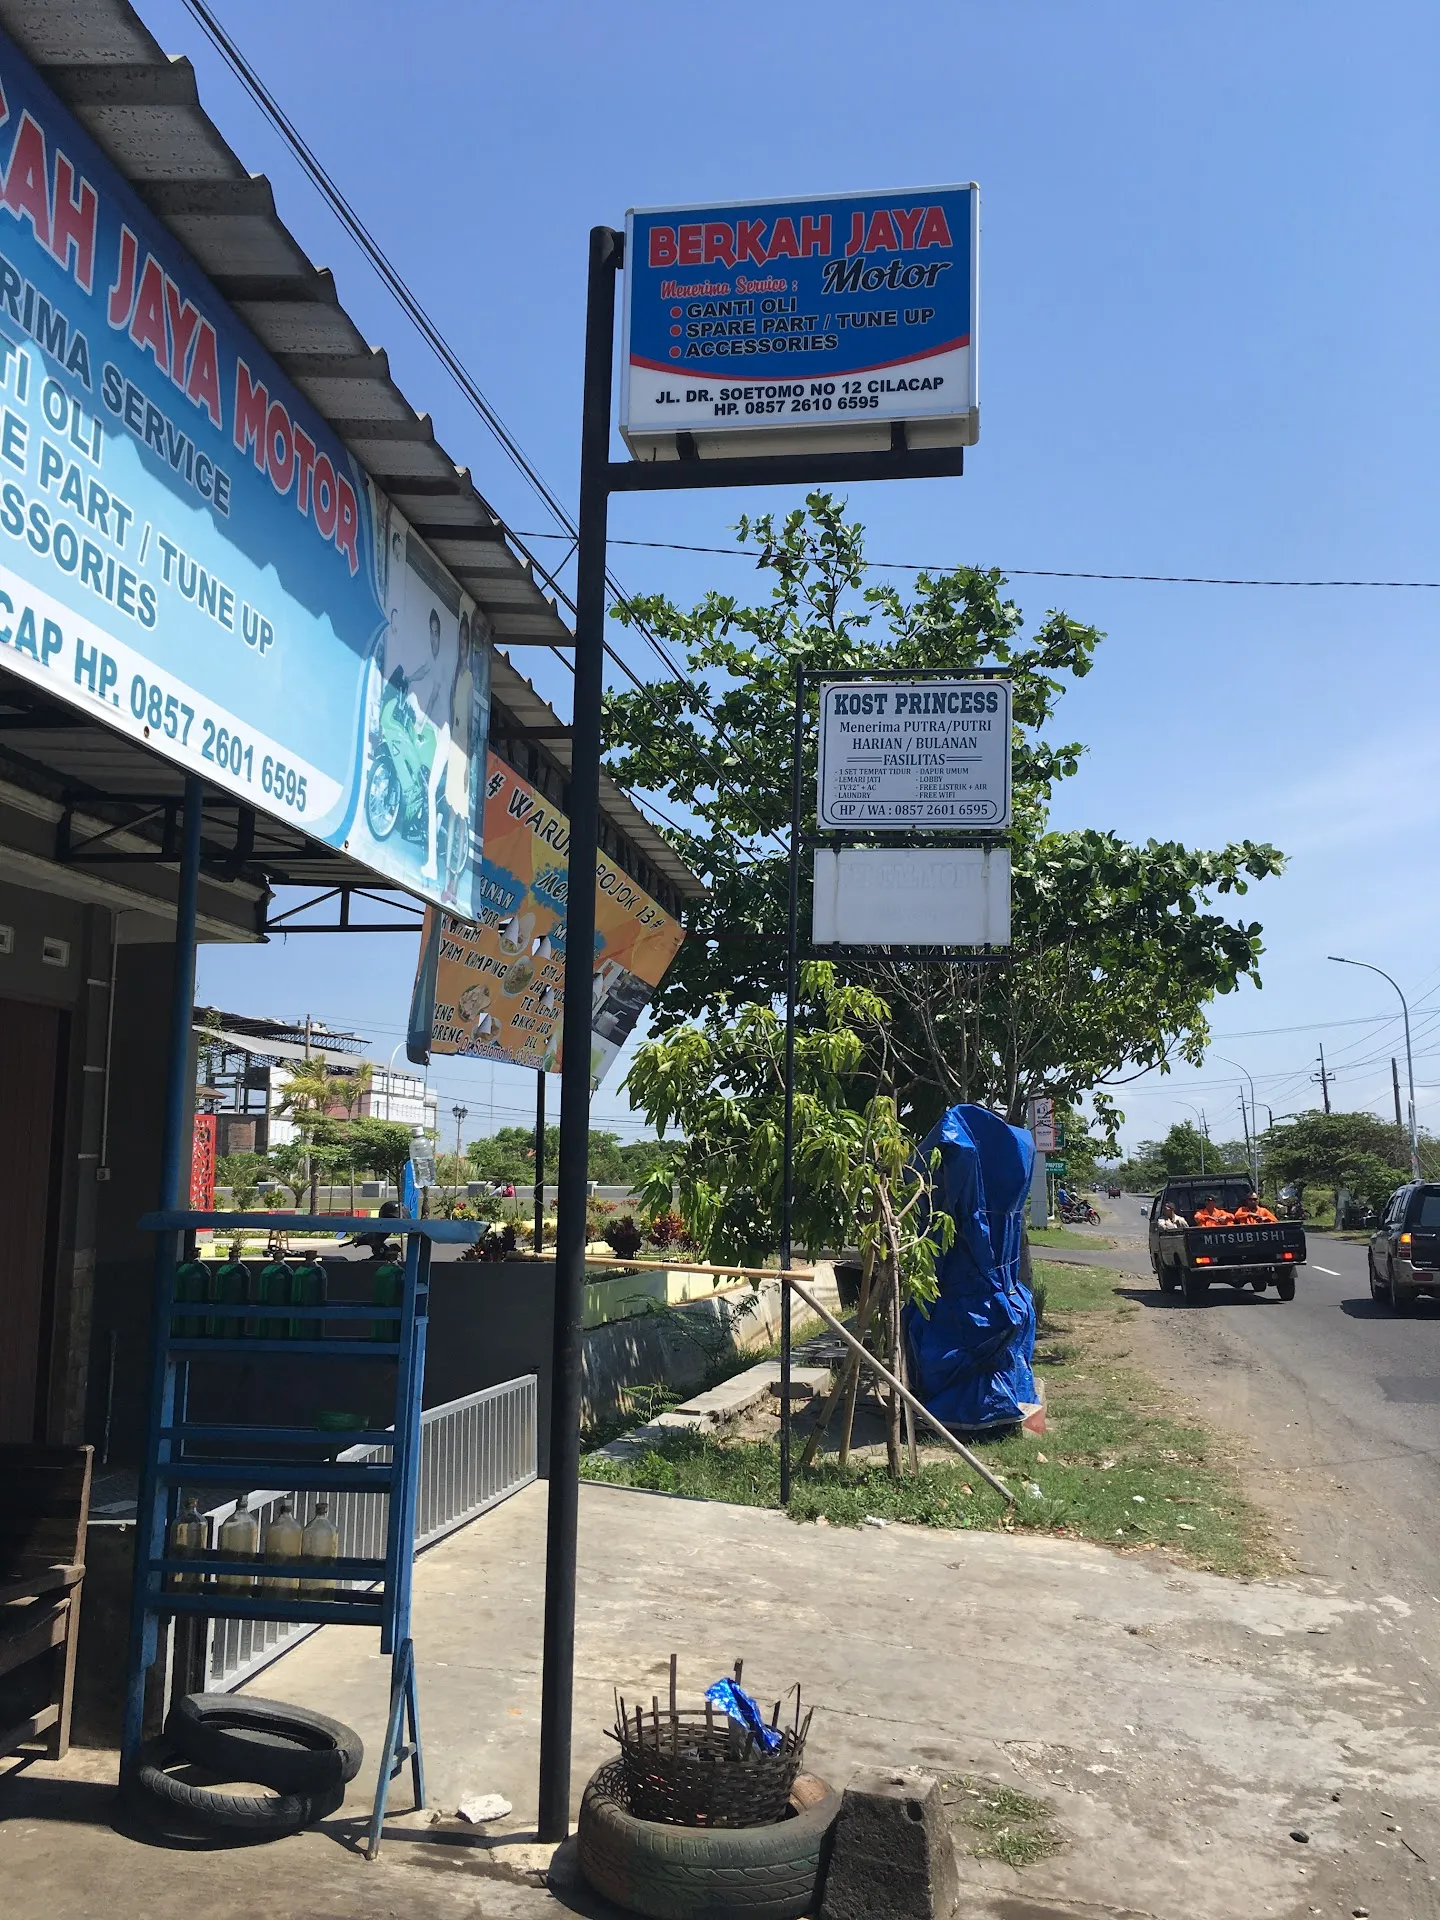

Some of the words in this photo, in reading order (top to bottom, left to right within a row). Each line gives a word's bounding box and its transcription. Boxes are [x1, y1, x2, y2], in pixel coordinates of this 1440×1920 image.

[649, 215, 832, 269] BERKAH
[845, 206, 953, 257] JAYA
[661, 279, 730, 299] Menerima
[736, 275, 786, 293] Service
[821, 258, 952, 294] Motor
[686, 300, 753, 319] GANTI
[761, 297, 797, 314] OLI
[686, 319, 755, 338] SPARE
[762, 315, 819, 334] PART
[837, 310, 897, 329] TUNE
[904, 308, 936, 325] UP
[685, 334, 839, 359] ACCESSORIES
[107, 223, 222, 431] JAYA
[233, 357, 359, 577] MOTOR
[656, 391, 680, 403] JL.
[686, 390, 714, 402] DR.
[720, 385, 804, 401] SOETOMO
[810, 382, 836, 396] NO
[842, 381, 861, 394] 12
[867, 377, 944, 393] CILACAP
[714, 402, 740, 416] HP.
[745, 400, 785, 415] 0857
[791, 398, 832, 412] 2610
[837, 396, 879, 410] 6595
[41, 376, 103, 470] OLI
[101, 361, 231, 518] SERVICE
[38, 436, 134, 548] PART
[157, 532, 236, 634] TUNE
[241, 601, 274, 658] UP
[834, 693, 887, 715] KOST
[895, 691, 998, 715] PRINCESS
[74, 637, 120, 708] HP.
[130, 673, 195, 747] 0857
[202, 717, 254, 784] 2601
[261, 754, 308, 813] 6595
[840, 721, 900, 733] Menerima
[904, 720, 991, 734] PUTRA/PUTRI
[852, 737, 902, 750] HARIAN
[916, 737, 977, 749] BULANAN
[883, 753, 945, 766] FASILITAS
[946, 767, 969, 775] UMUM
[839, 804, 856, 816] HP
[868, 804, 886, 816] WA
[895, 804, 924, 815] 0857
[927, 804, 955, 815] 2601
[959, 804, 988, 815] 6595
[1203, 1230, 1286, 1245] MITSUBISHI
